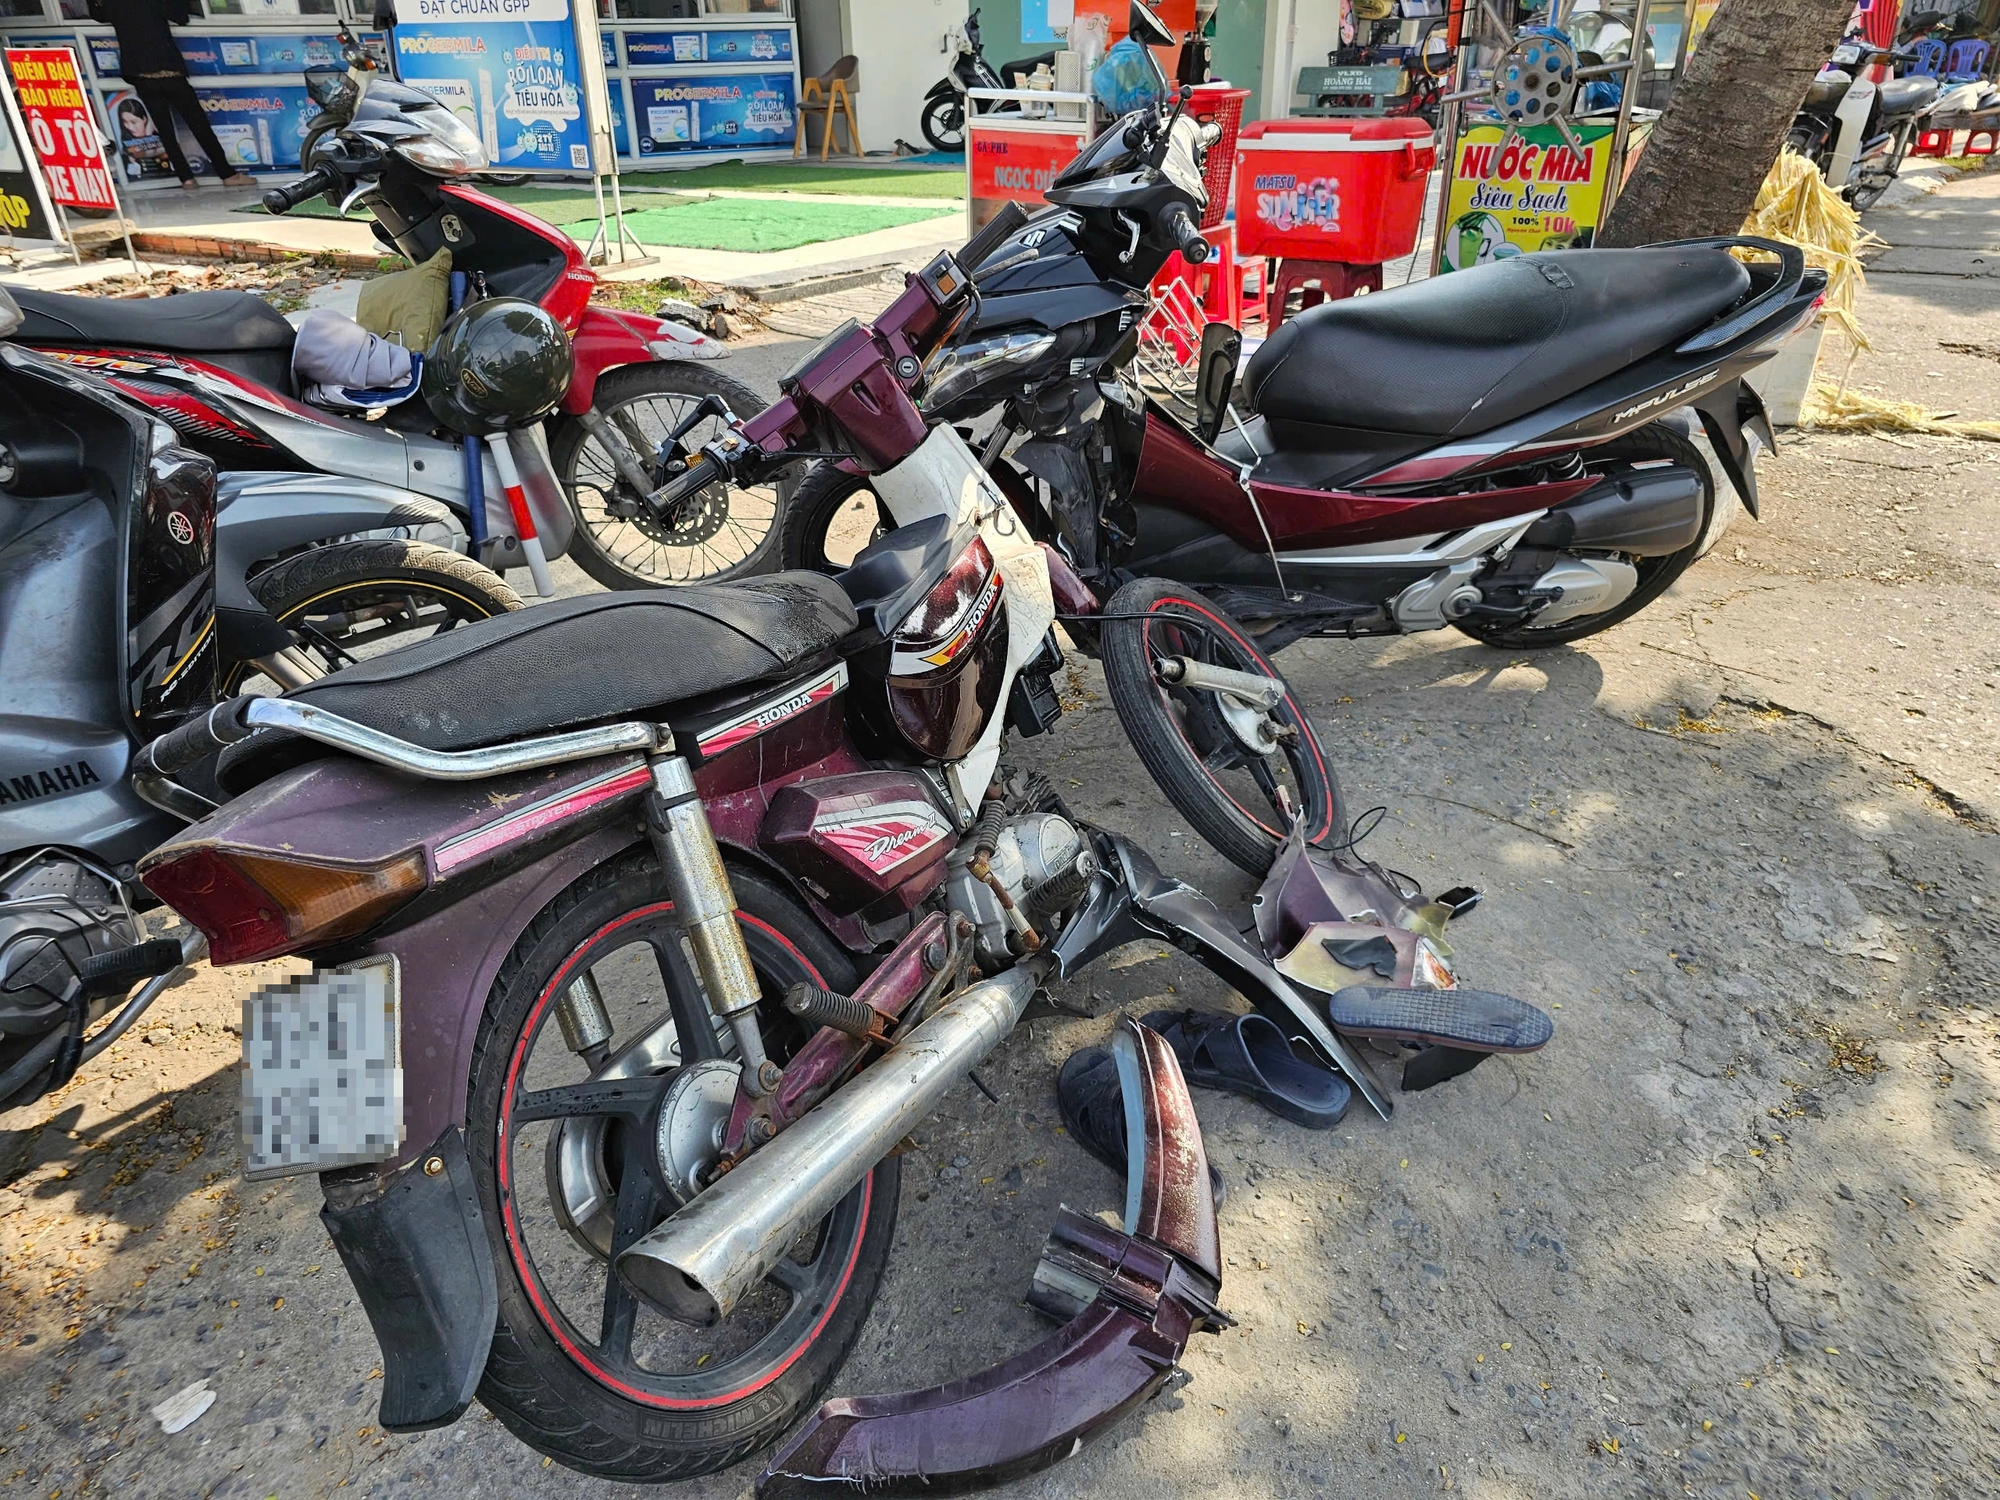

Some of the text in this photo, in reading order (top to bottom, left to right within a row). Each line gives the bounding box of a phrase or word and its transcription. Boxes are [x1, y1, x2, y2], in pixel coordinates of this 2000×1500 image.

[503, 0, 530, 13] GPP
[399, 36, 487, 54] PROGERMILA
[12, 54, 75, 81] ĐIỂM BÁN
[20, 81, 83, 108] BẢO HIỂM
[515, 89, 538, 107] TIÊU
[654, 86, 742, 101] PROGERMILA
[31, 109, 98, 158] Ô TÔ
[1459, 132, 1594, 183] NƯỚC MÍA
[44, 159, 112, 204] XE MÁY
[994, 159, 1058, 194] NGỌC DIỄ
[1254, 175, 1296, 190] MATSU
[1256, 189, 1340, 222] SUMMER
[1470, 182, 1568, 216] Siêu Sạch
[1512, 217, 1539, 226] 100%
[567, 272, 595, 283] HONDA
[966, 584, 998, 637] HONDA
[755, 692, 813, 727] HONDA
[0, 760, 101, 805] AMAHA
[645, 1406, 756, 1438] MICHELIN
